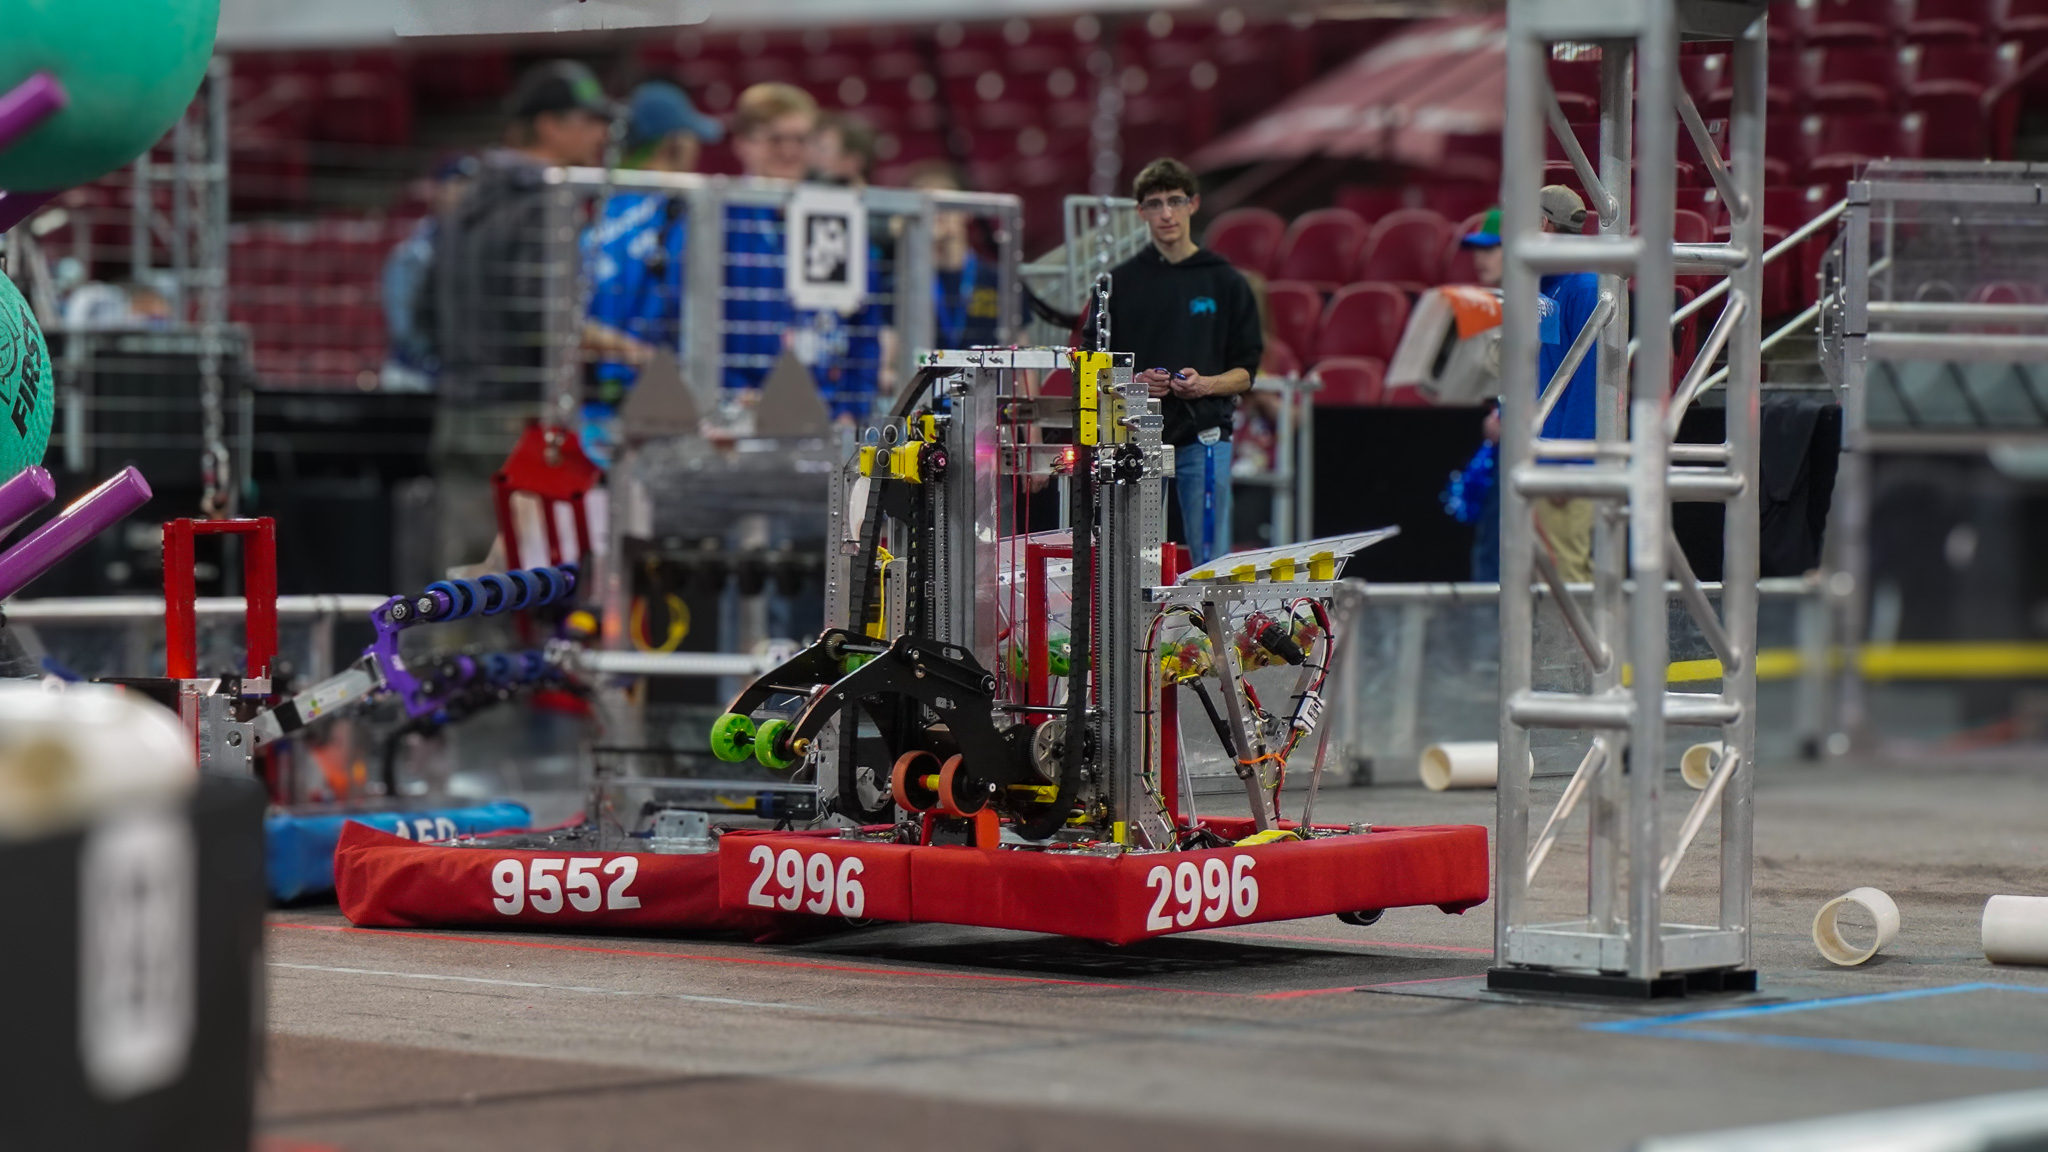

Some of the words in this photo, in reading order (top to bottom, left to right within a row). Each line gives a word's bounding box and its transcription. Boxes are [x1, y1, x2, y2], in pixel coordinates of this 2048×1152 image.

[11, 304, 41, 439] FIRST
[492, 856, 642, 915] 9552
[748, 844, 865, 918] 2996
[1146, 854, 1259, 931] 2996
